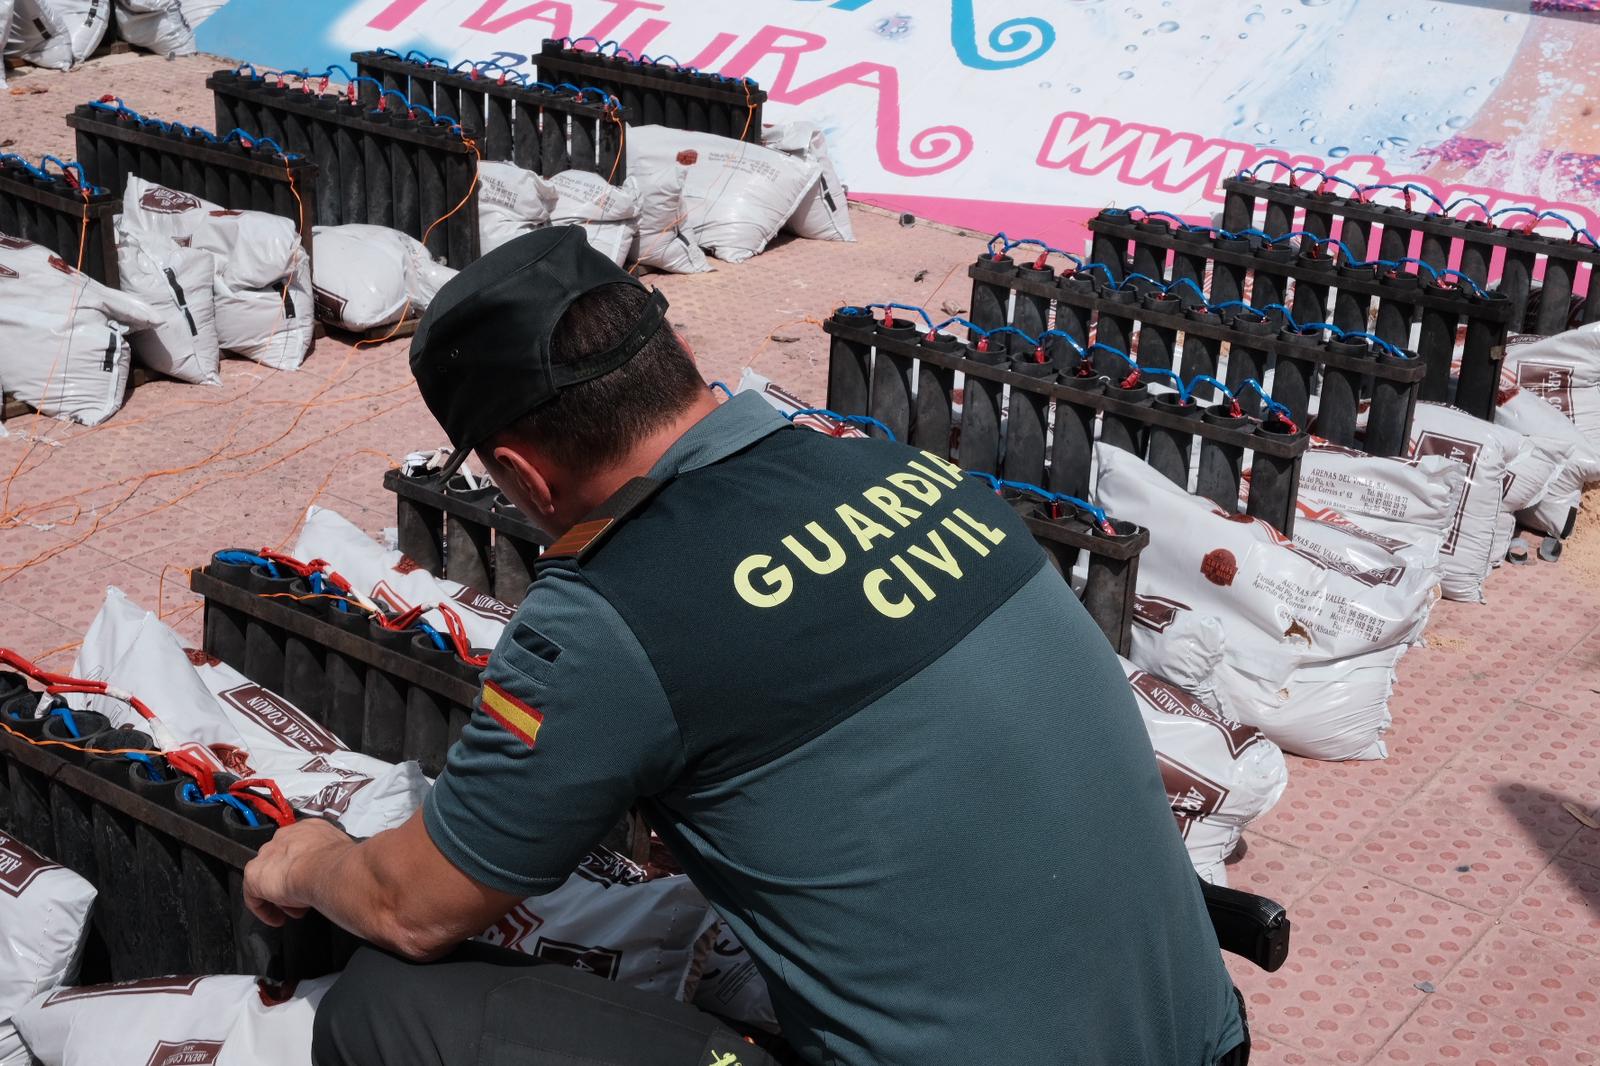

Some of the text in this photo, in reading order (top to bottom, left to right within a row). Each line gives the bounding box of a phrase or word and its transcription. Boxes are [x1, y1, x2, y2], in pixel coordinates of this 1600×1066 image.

[1310, 468, 1337, 481] ARENAS
[1338, 473, 1352, 484] DEL
[733, 450, 964, 608] GUARDIA
[863, 508, 1007, 619] CIVIL
[1308, 543, 1322, 554] DEL
[1285, 597, 1307, 611] Correos
[246, 695, 288, 728] COMUN
[1150, 687, 1191, 717] OMUN
